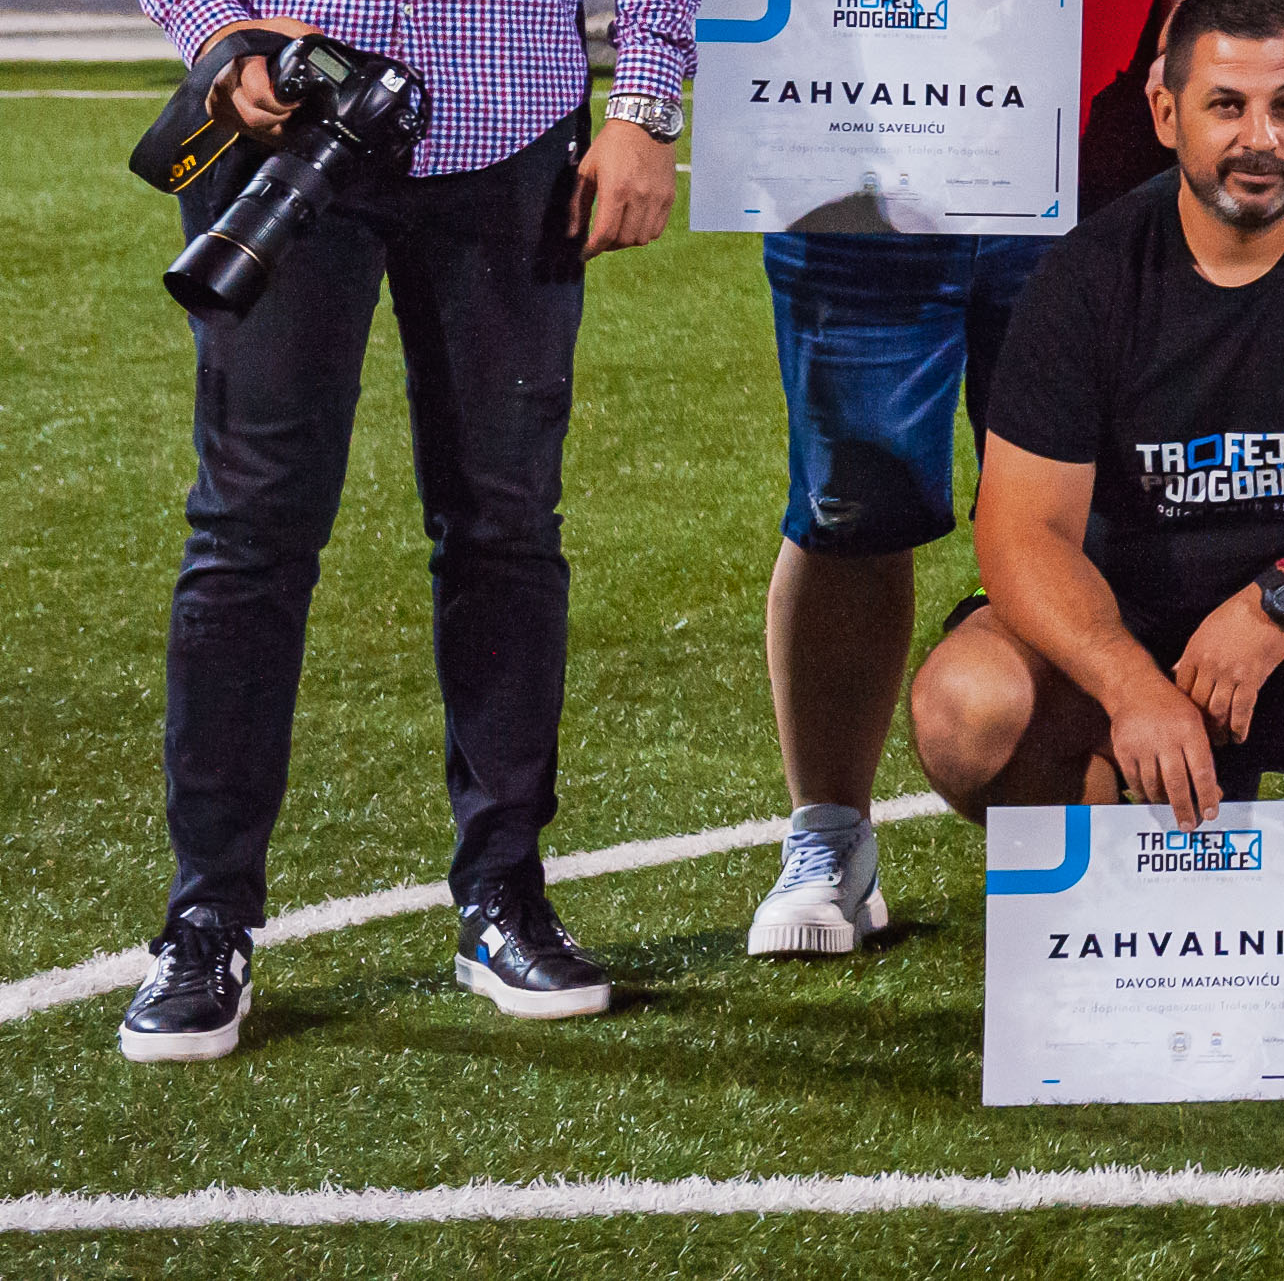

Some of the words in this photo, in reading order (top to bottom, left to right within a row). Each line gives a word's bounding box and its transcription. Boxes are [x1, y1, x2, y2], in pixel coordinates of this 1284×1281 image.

[833, 10, 937, 29] PODGORICE
[750, 80, 1025, 109] ZAHVALNICA
[829, 122, 874, 133] MOMU
[1137, 830, 1226, 851] TROFEJ
[1137, 852, 1250, 872] PODGORICE
[1115, 976, 1176, 990] DAVORU
[1181, 972, 1280, 988] MATANOVIĆU
